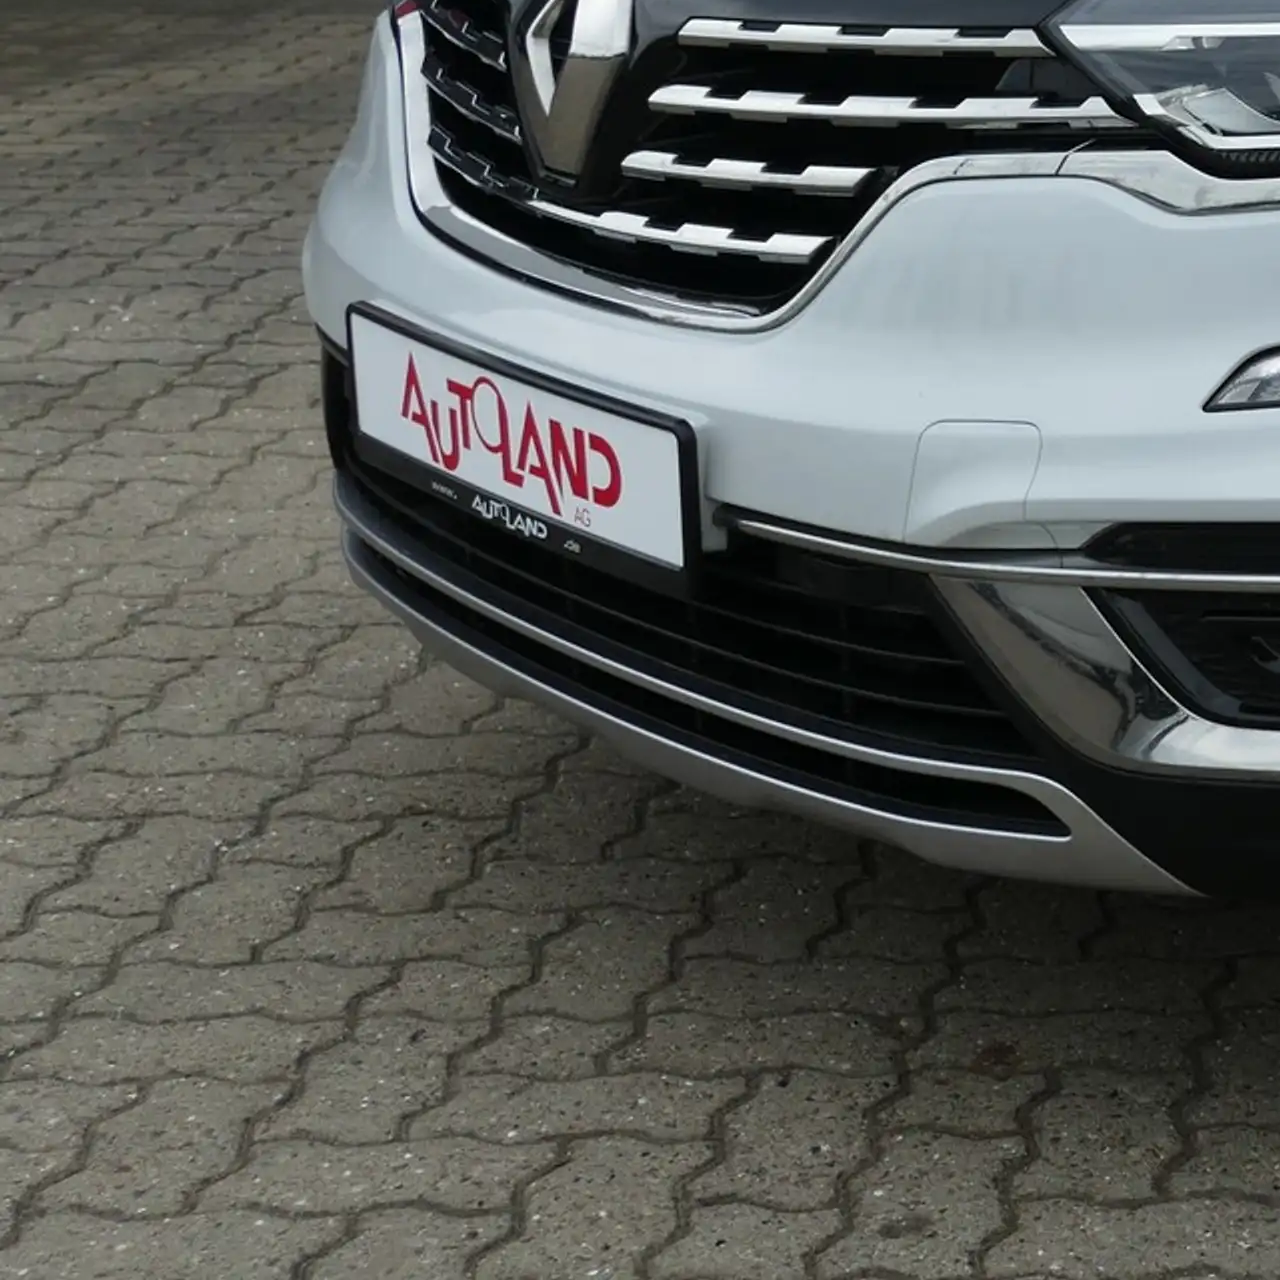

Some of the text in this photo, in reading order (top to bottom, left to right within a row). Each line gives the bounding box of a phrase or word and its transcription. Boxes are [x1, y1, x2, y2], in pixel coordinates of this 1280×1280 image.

[401, 350, 622, 528] AUTOLAND AG
[471, 494, 548, 539] AUTOLAND
